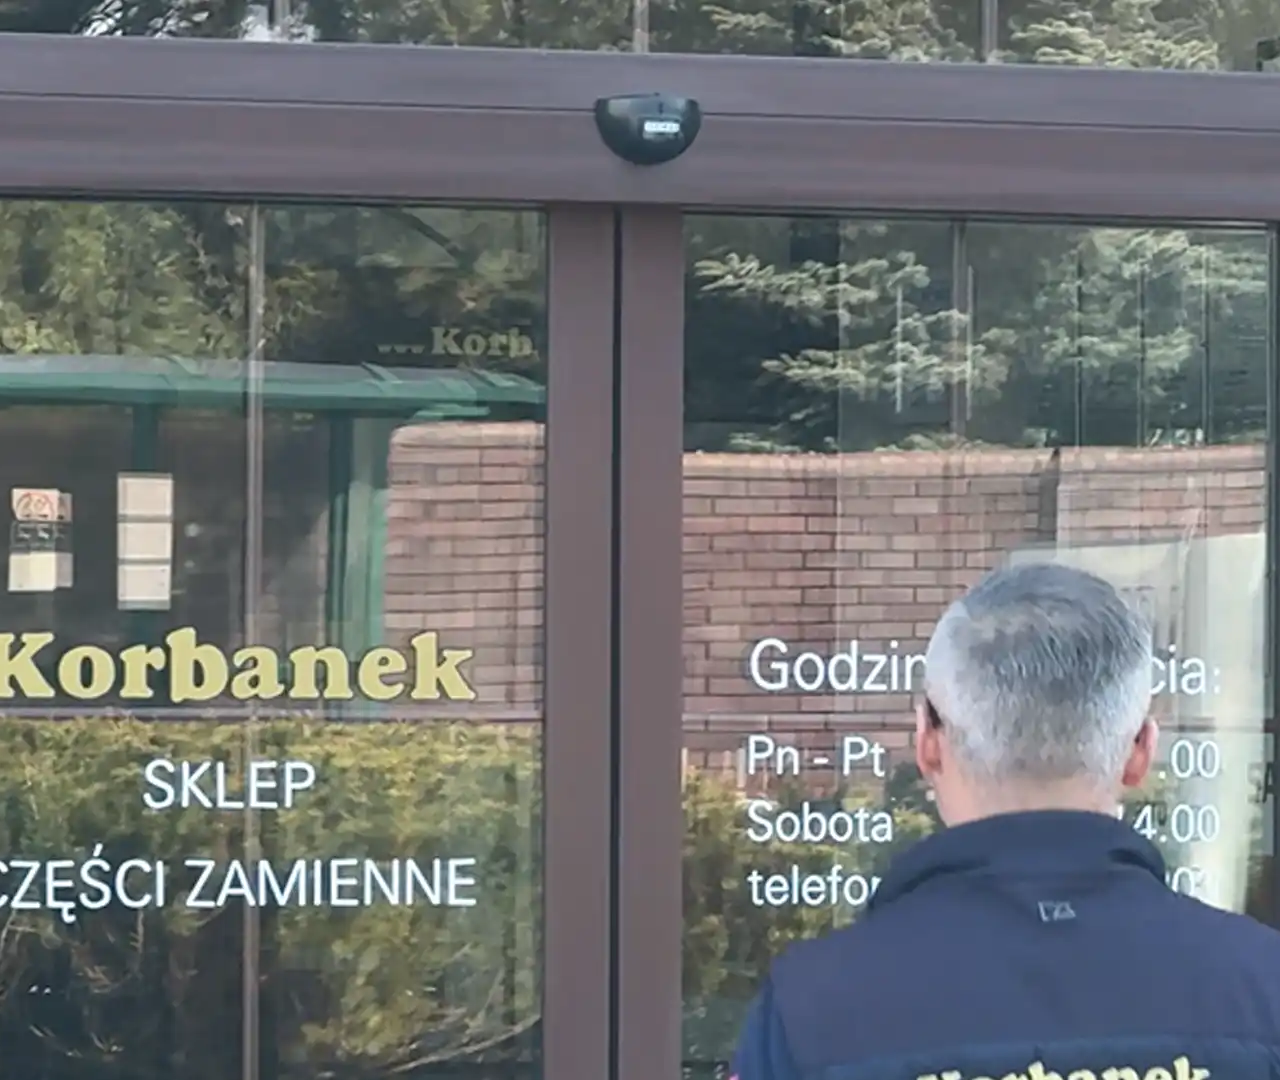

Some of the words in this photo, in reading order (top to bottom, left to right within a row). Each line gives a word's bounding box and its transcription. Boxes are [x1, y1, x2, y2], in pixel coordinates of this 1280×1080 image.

[750, 637, 928, 692] Godzin
[748, 734, 800, 776] Pn
[842, 736, 886, 778] Pt
[1159, 739, 1221, 779] .00
[142, 758, 317, 810] SKLEP
[747, 799, 894, 843] Sobota
[185, 858, 477, 907] ZAMIENNE
